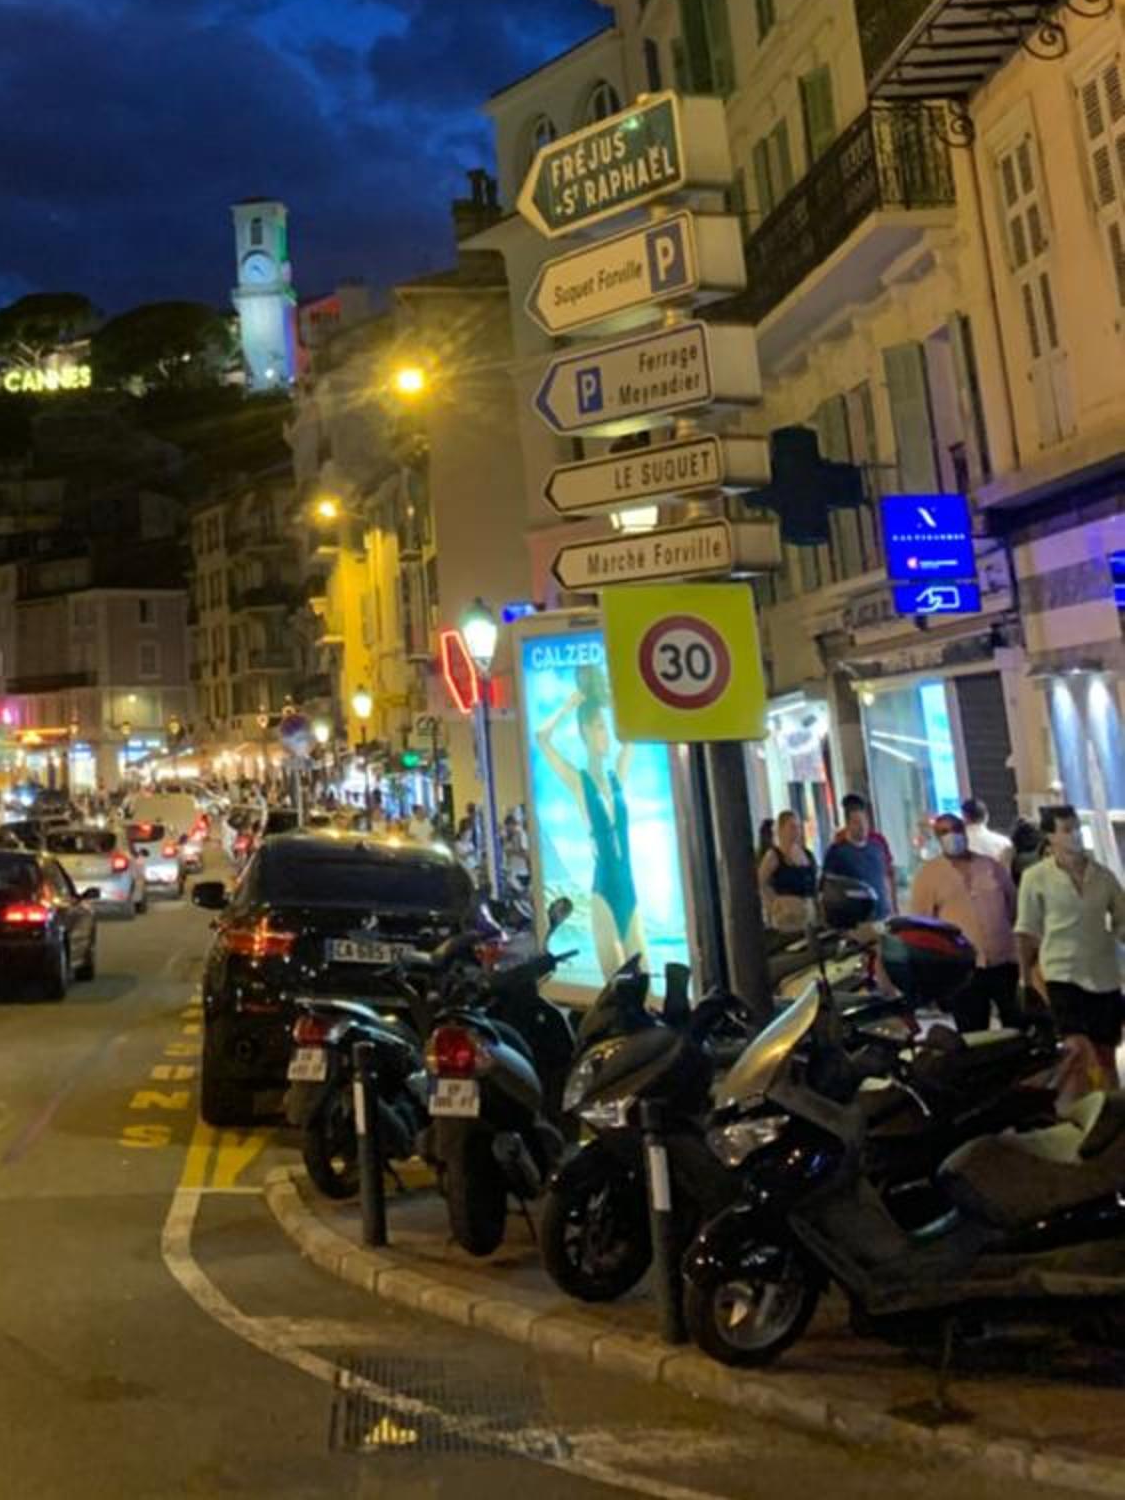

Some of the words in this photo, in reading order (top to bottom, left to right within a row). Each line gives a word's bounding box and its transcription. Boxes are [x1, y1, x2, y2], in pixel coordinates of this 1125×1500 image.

[654, 236, 675, 282] P
[3, 363, 92, 393] CANNES
[580, 373, 597, 409] P
[614, 465, 631, 491] LE
[640, 451, 710, 485] SUQUET
[653, 536, 722, 567] Forville
[658, 642, 713, 683] 30
